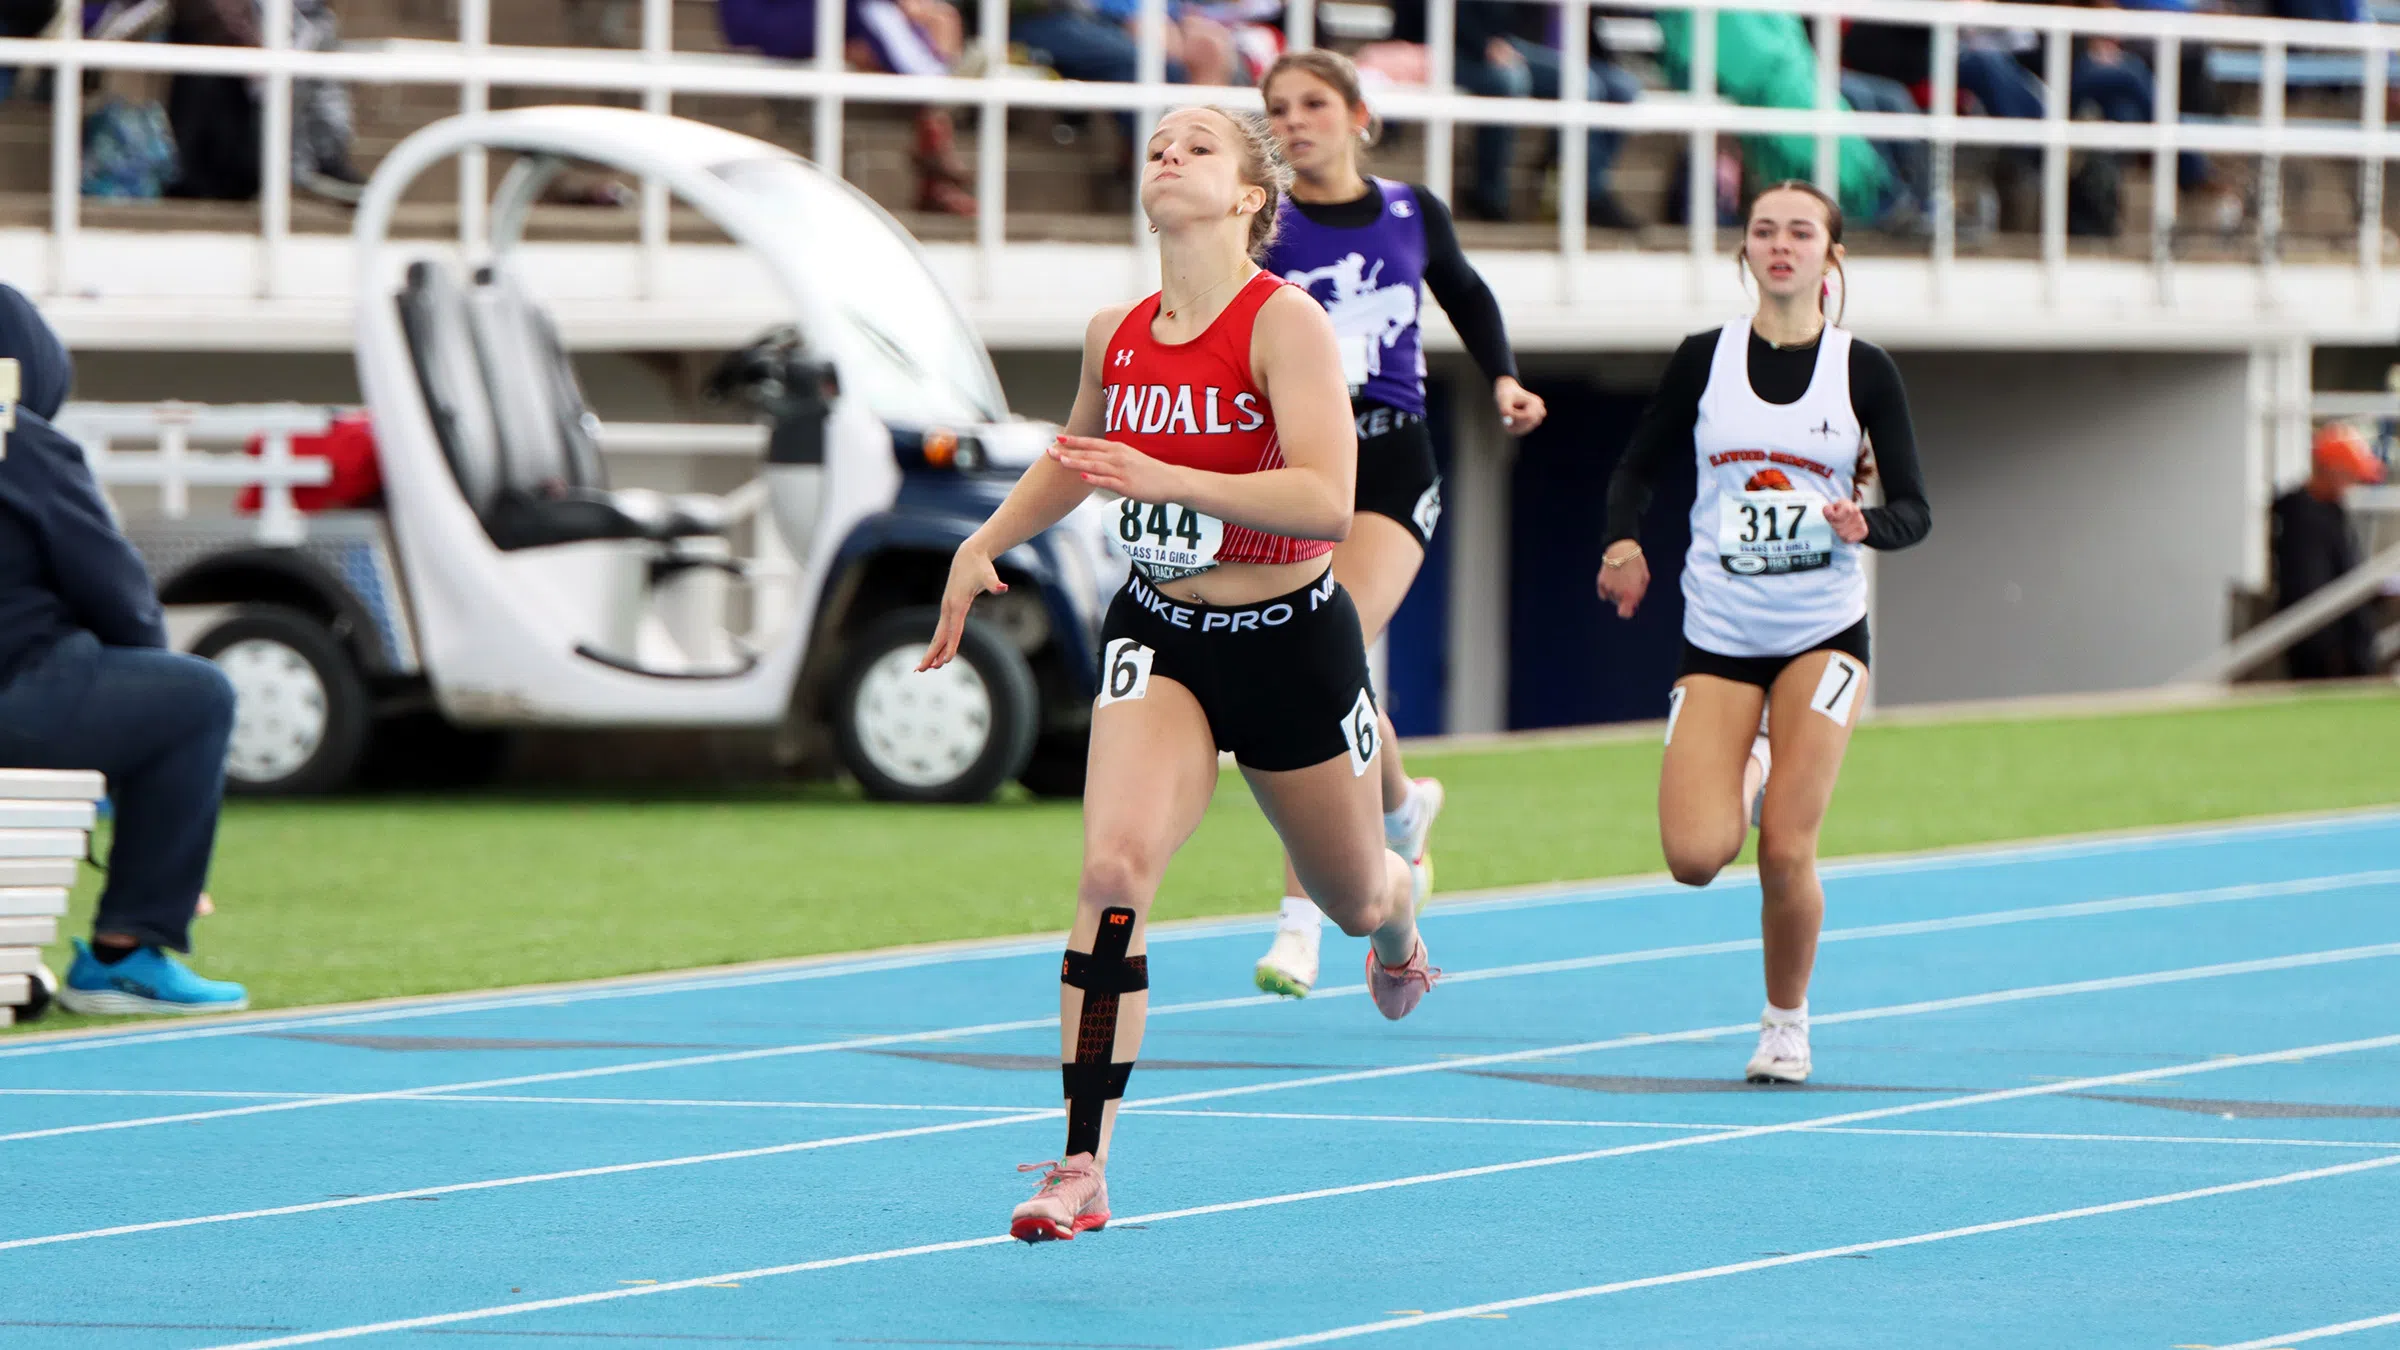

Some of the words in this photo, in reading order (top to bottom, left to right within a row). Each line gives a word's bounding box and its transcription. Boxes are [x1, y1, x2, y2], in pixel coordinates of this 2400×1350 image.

[1120, 498, 1202, 550] 844
[1740, 505, 1807, 542] 317
[1150, 564, 1175, 579] TRACK
[1155, 549, 1166, 561] 1A
[1169, 551, 1198, 565] GIRLS
[1128, 576, 1195, 629] NIKE
[1201, 603, 1293, 632] PRO
[1110, 641, 1143, 698] 6
[1825, 661, 1854, 710] 7
[1355, 702, 1374, 763] 6
[1109, 914, 1129, 925] KT
